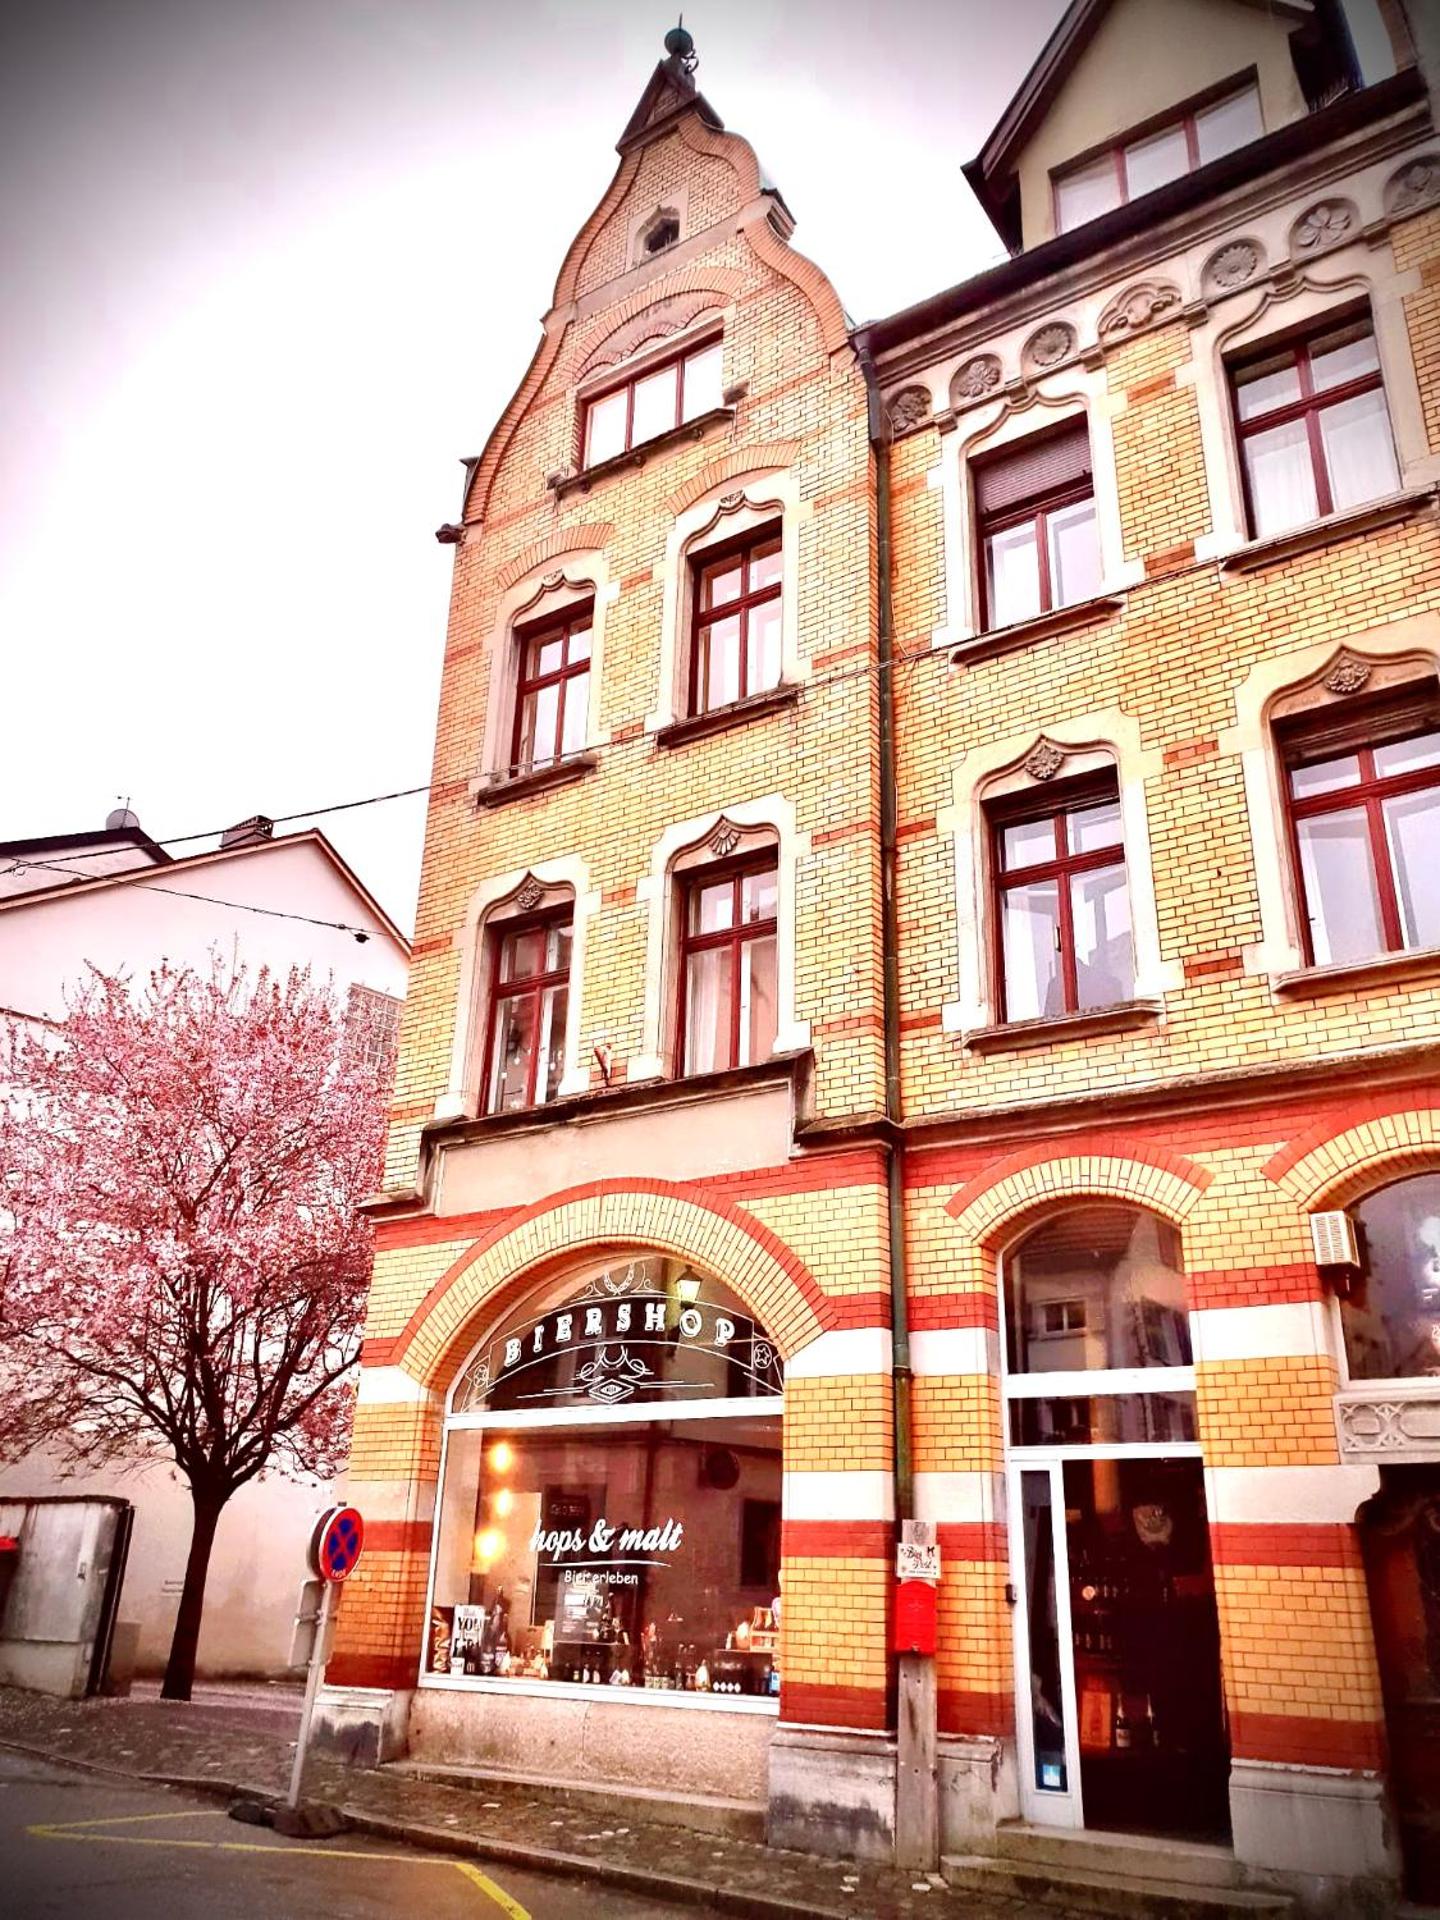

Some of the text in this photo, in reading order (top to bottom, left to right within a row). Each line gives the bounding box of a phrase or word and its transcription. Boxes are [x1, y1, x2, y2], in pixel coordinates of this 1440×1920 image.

[503, 1303, 735, 1367] BIERSHOP
[528, 1517, 683, 1561] hops & malt
